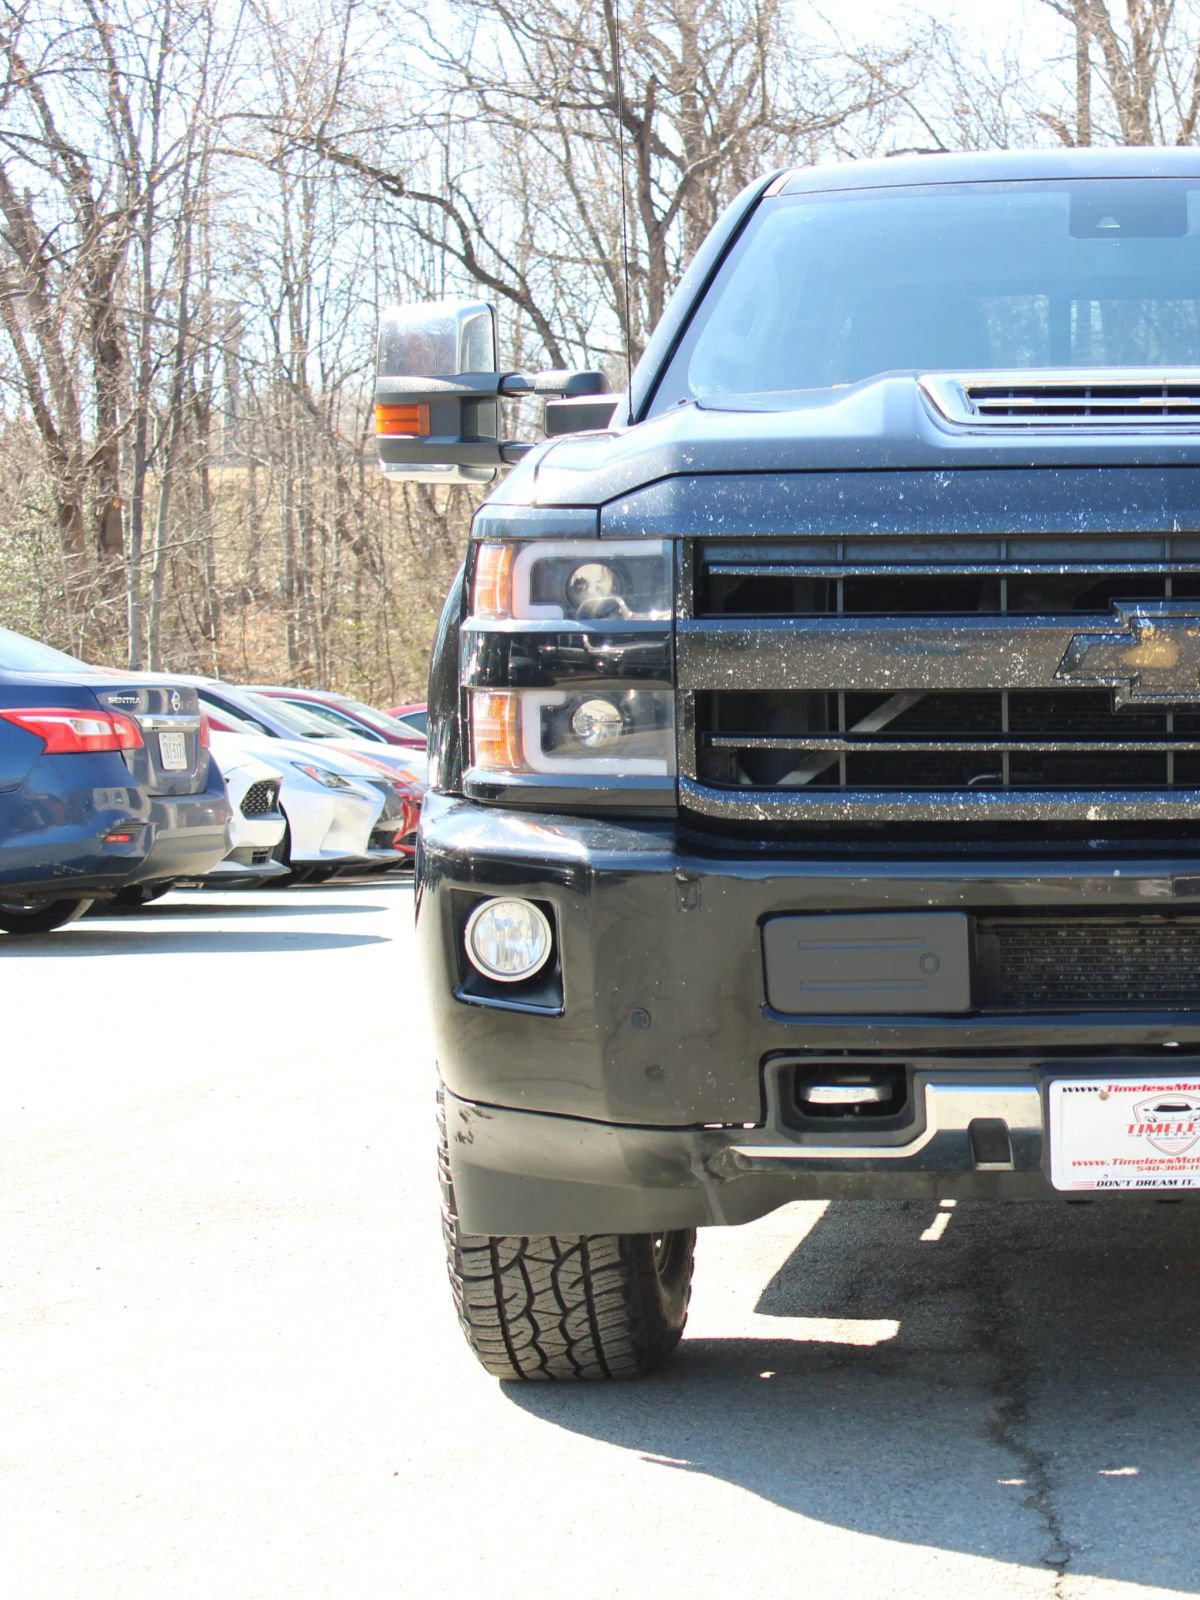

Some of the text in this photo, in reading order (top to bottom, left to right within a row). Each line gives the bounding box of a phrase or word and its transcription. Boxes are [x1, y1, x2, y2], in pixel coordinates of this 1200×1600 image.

[107, 696, 141, 705] SENTRA
[1096, 1179, 1132, 1187] DON'T
[1136, 1179, 1177, 1187] DREAM
